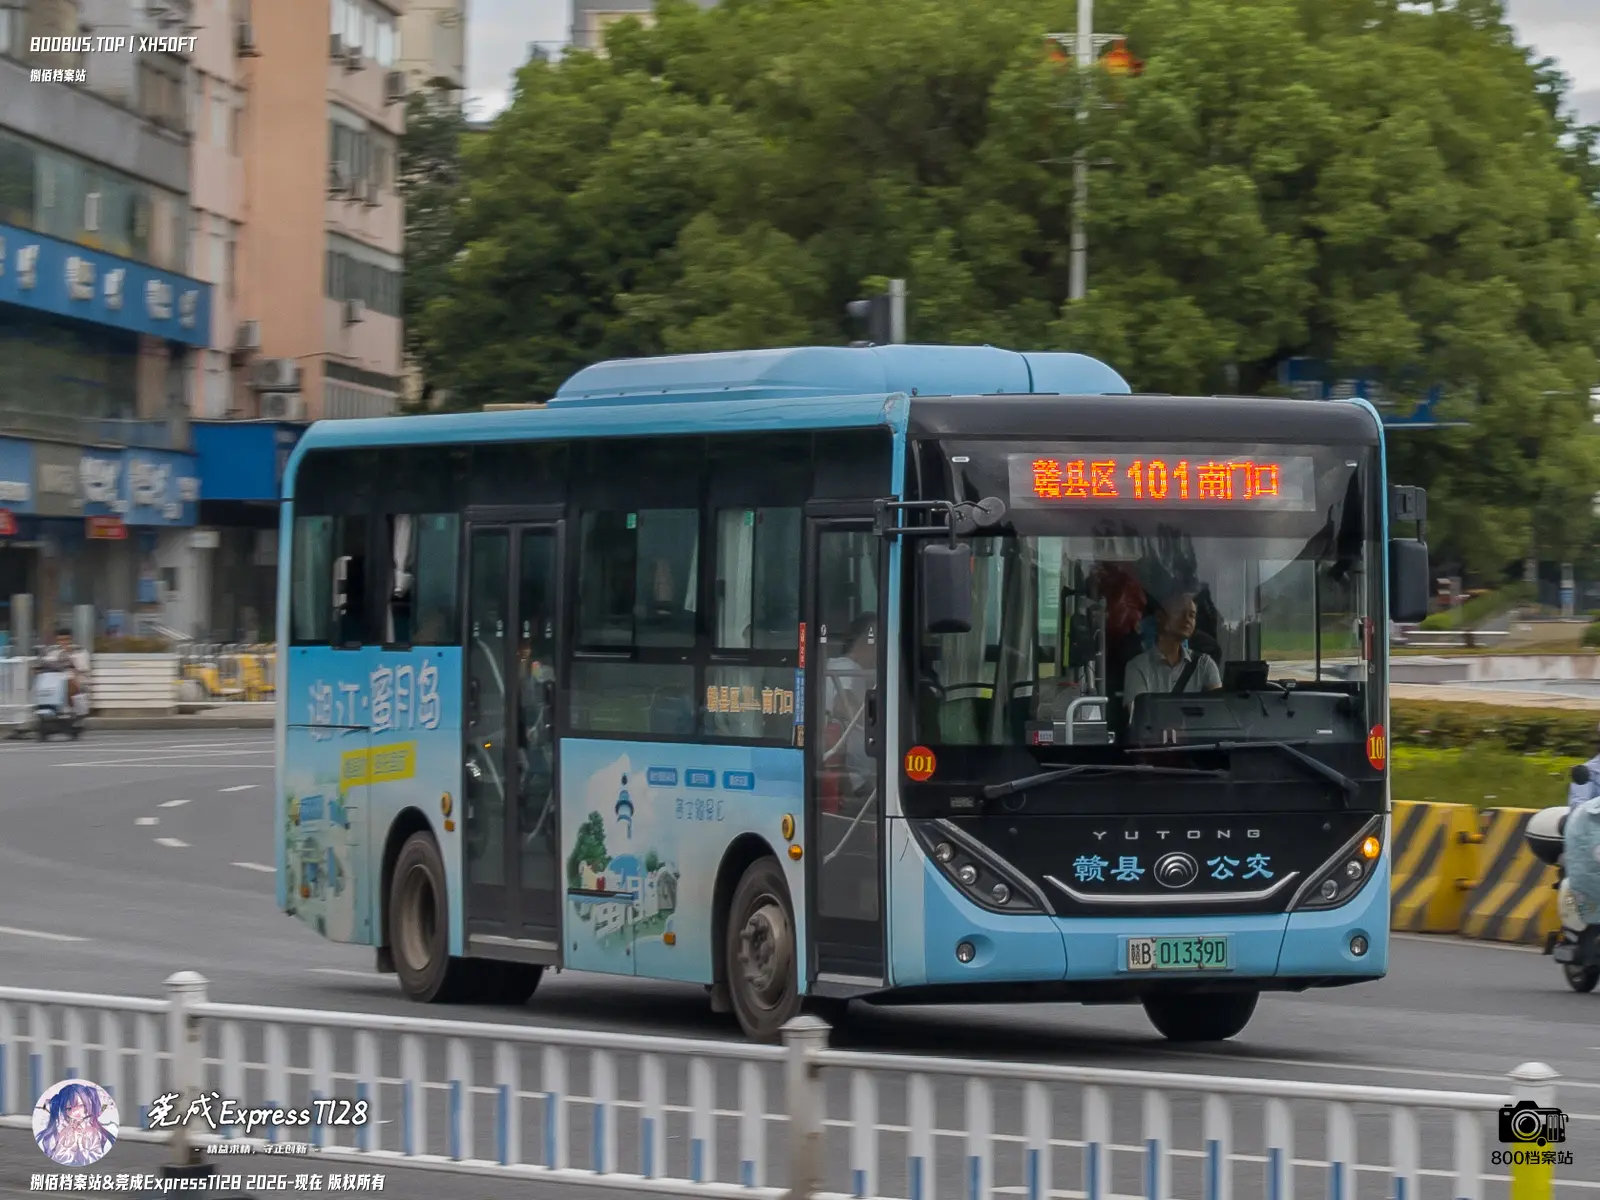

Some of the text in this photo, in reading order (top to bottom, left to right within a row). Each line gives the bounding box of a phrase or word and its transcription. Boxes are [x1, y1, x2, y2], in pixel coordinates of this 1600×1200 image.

[1033, 460, 1279, 499] 赣县区 101 南门口
[907, 755, 934, 773] 101
[1093, 829, 1260, 840] YUTONG
[1072, 853, 1274, 882] 赣县 公交
